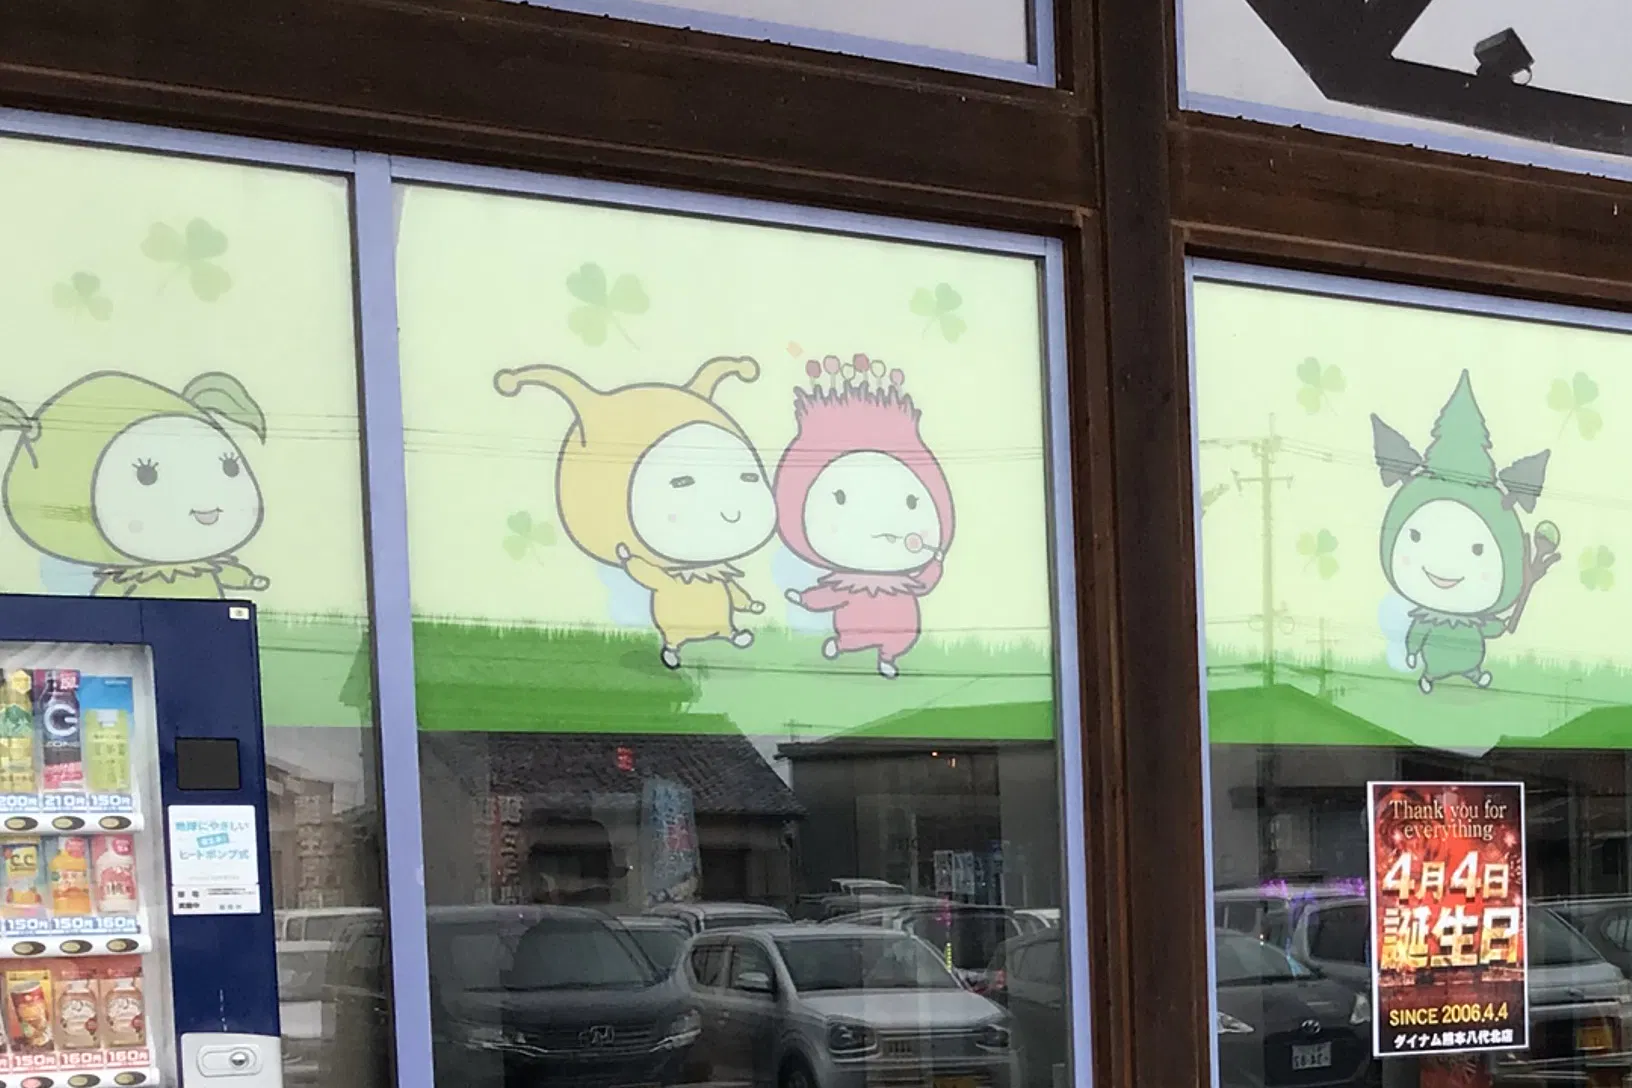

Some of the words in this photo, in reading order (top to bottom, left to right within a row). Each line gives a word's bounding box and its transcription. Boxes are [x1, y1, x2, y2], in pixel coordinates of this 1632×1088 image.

[1390, 800, 1443, 819] Thank
[1450, 801, 1479, 822] you
[1484, 799, 1507, 819] for
[1404, 819, 1494, 841] everything
[1382, 851, 1511, 901] 4月4日
[1380, 904, 1521, 970] 誕生日
[1389, 1007, 1439, 1026] SINCE
[1442, 1001, 1508, 1022] 2006.4.4
[1394, 1029, 1514, 1049] ダイナム熊本八代北店
